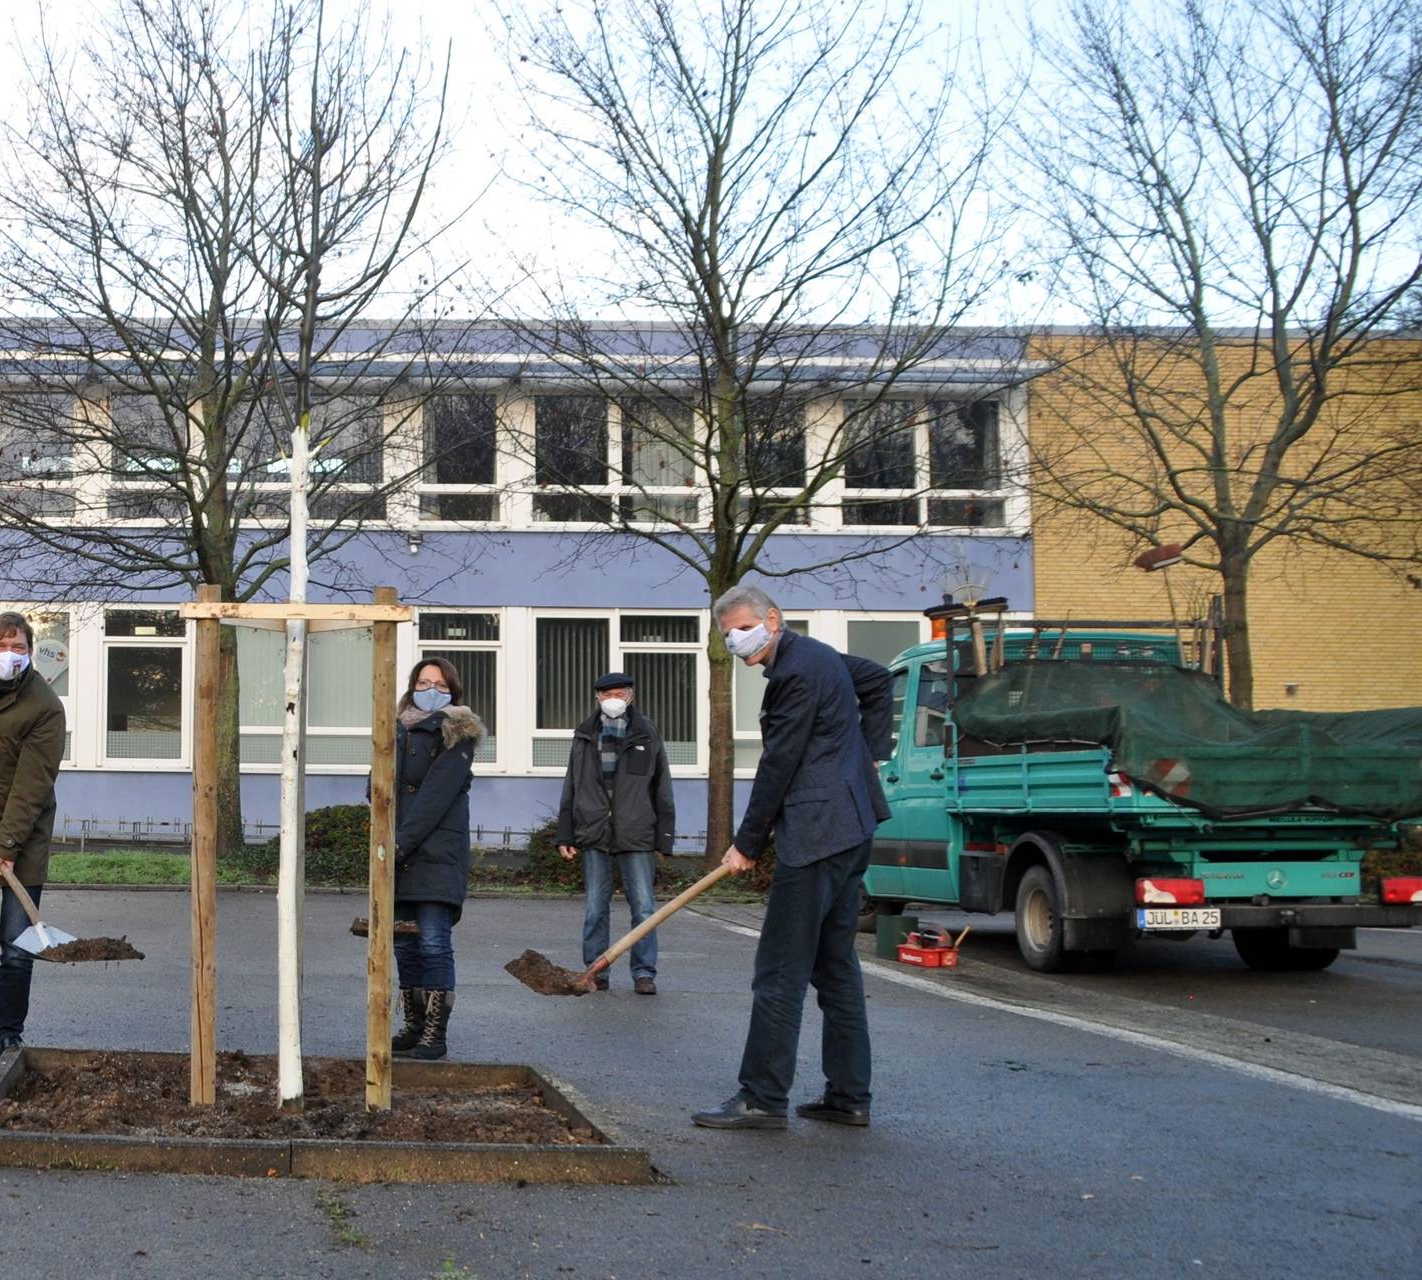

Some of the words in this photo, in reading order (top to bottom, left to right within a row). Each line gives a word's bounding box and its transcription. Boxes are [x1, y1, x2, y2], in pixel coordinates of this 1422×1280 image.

[39, 647, 56, 658] vhs
[1147, 911, 1172, 925] JÜL
[1181, 911, 1199, 925] BA
[1202, 911, 1219, 925] 25
